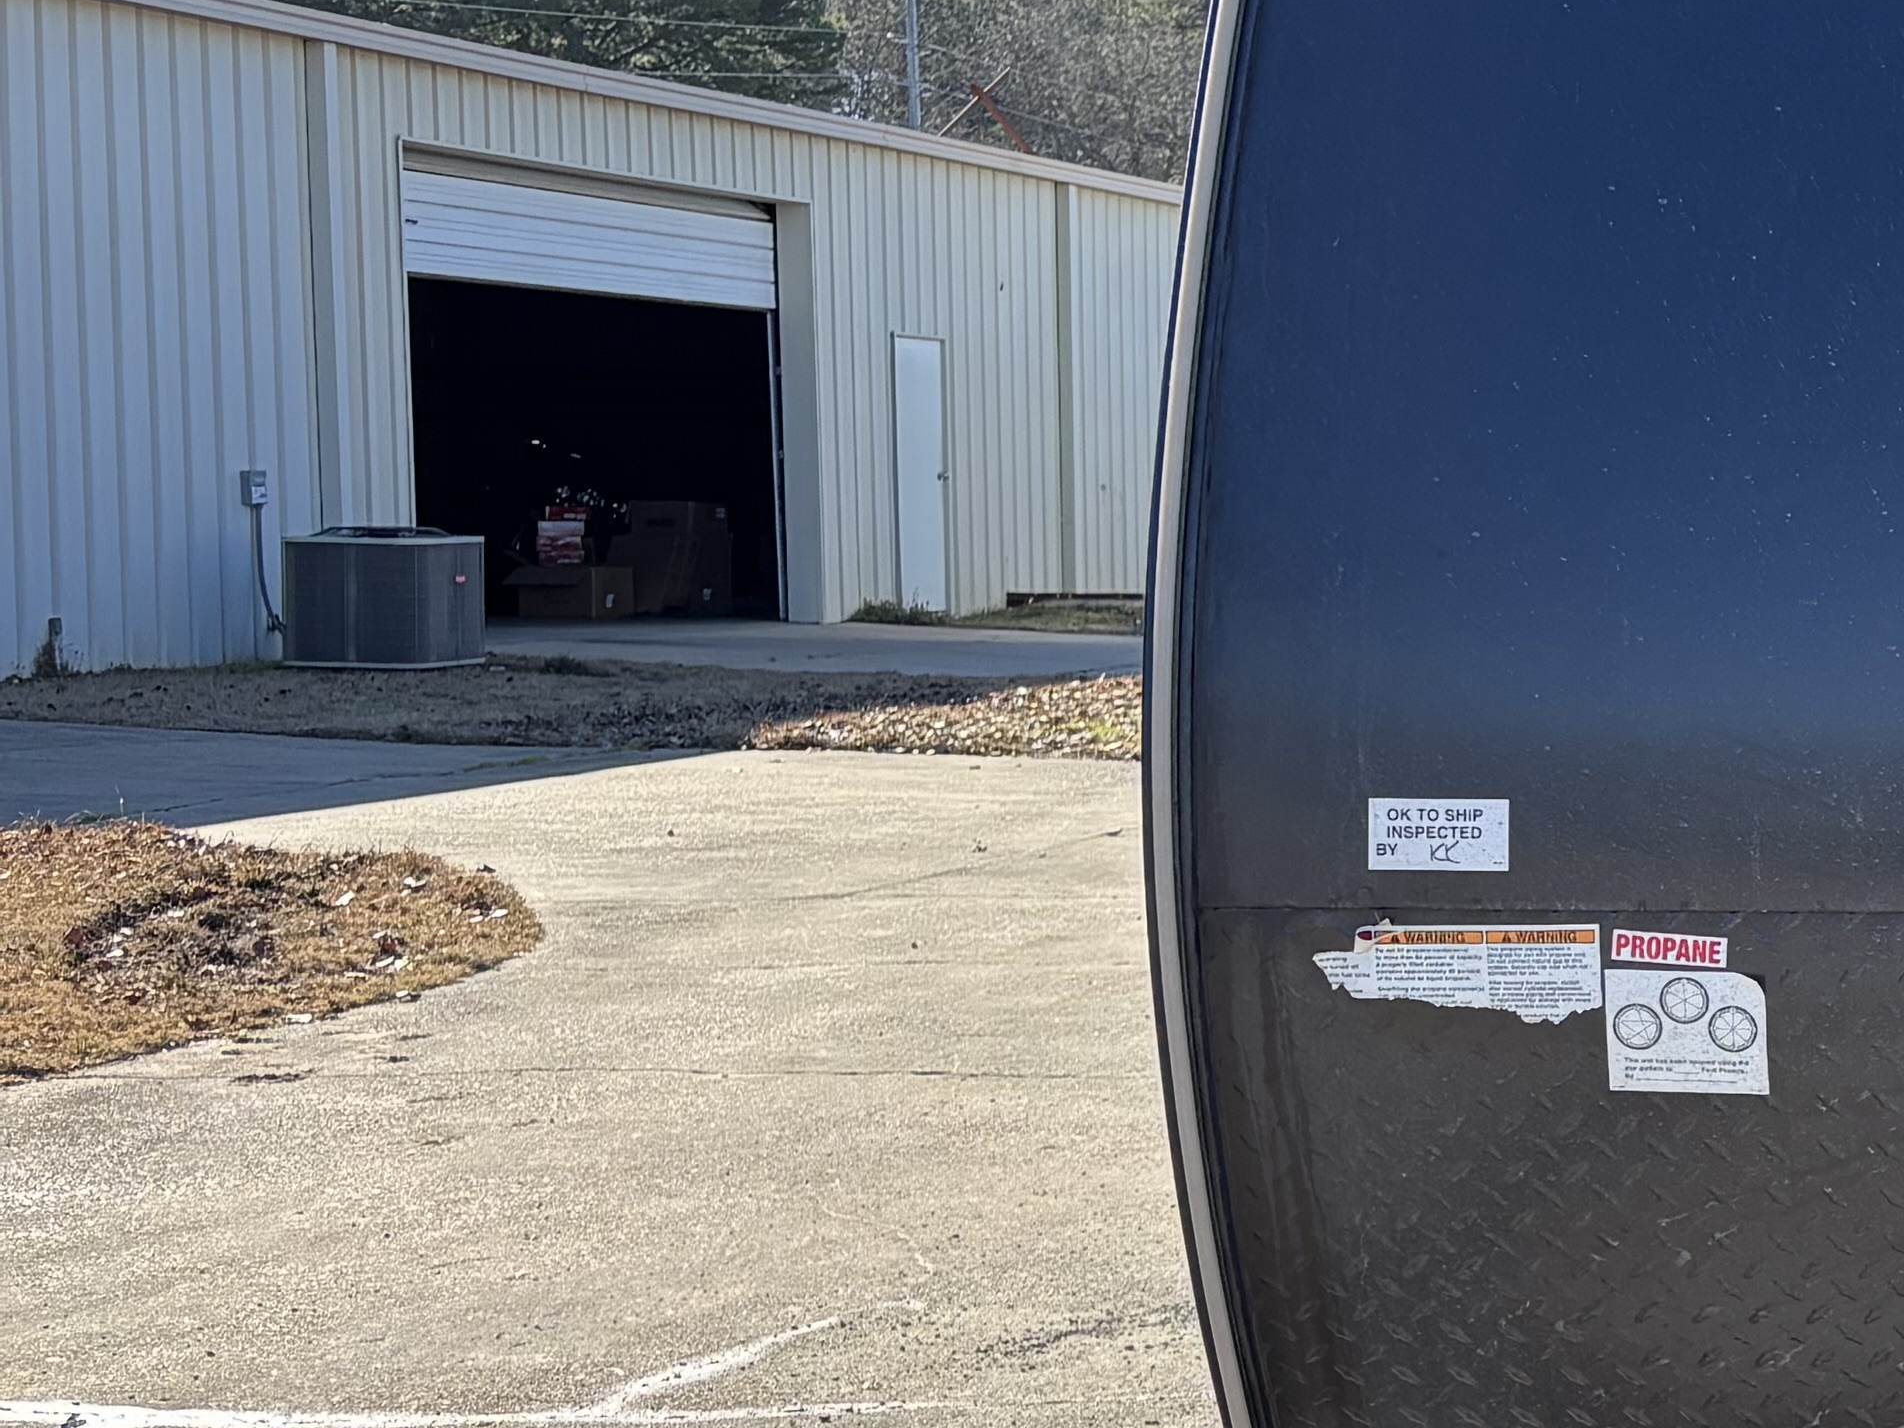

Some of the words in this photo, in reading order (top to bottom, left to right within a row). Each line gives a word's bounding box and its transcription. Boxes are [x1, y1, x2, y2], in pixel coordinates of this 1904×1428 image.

[1387, 808, 1411, 822] OK
[1416, 808, 1440, 822] TO
[1445, 808, 1484, 822] SHIP
[1387, 825, 1482, 840] INSPECTED
[1376, 843, 1398, 856] BY
[1517, 931, 1578, 943] WARNING
[1616, 934, 1722, 964] PROPANE
